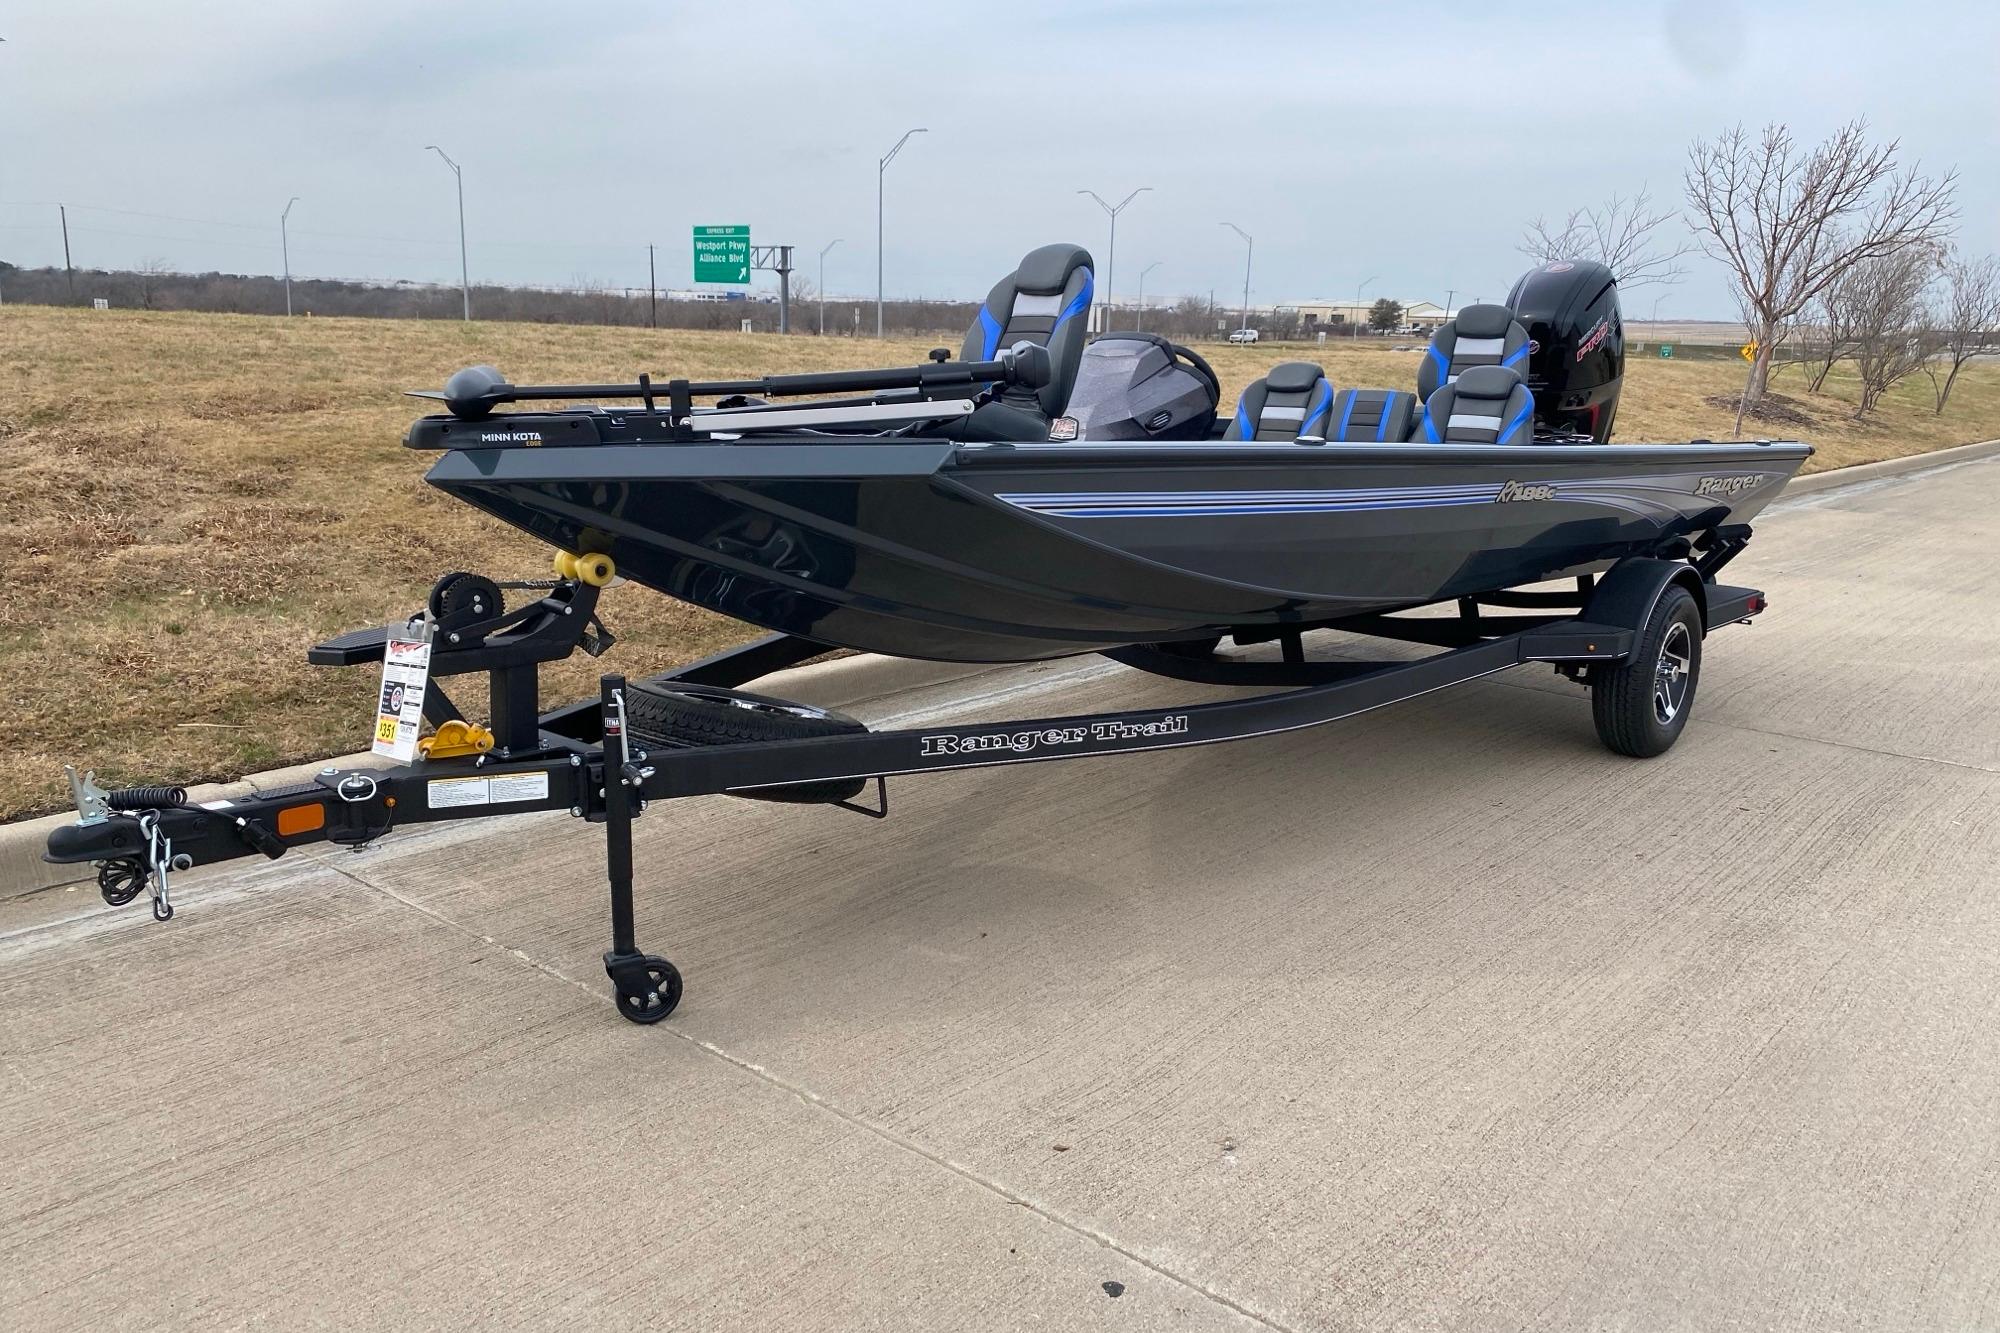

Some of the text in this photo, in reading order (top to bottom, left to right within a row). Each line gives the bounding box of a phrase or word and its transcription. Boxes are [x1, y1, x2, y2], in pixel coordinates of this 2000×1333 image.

[696, 241, 746, 252] Westport Pkwy
[699, 253, 744, 262] Alliance Blvd
[481, 432, 542, 442] MINN KOTA
[1693, 474, 1764, 496] Ranger
[921, 715, 1188, 756] Ranger Trail
